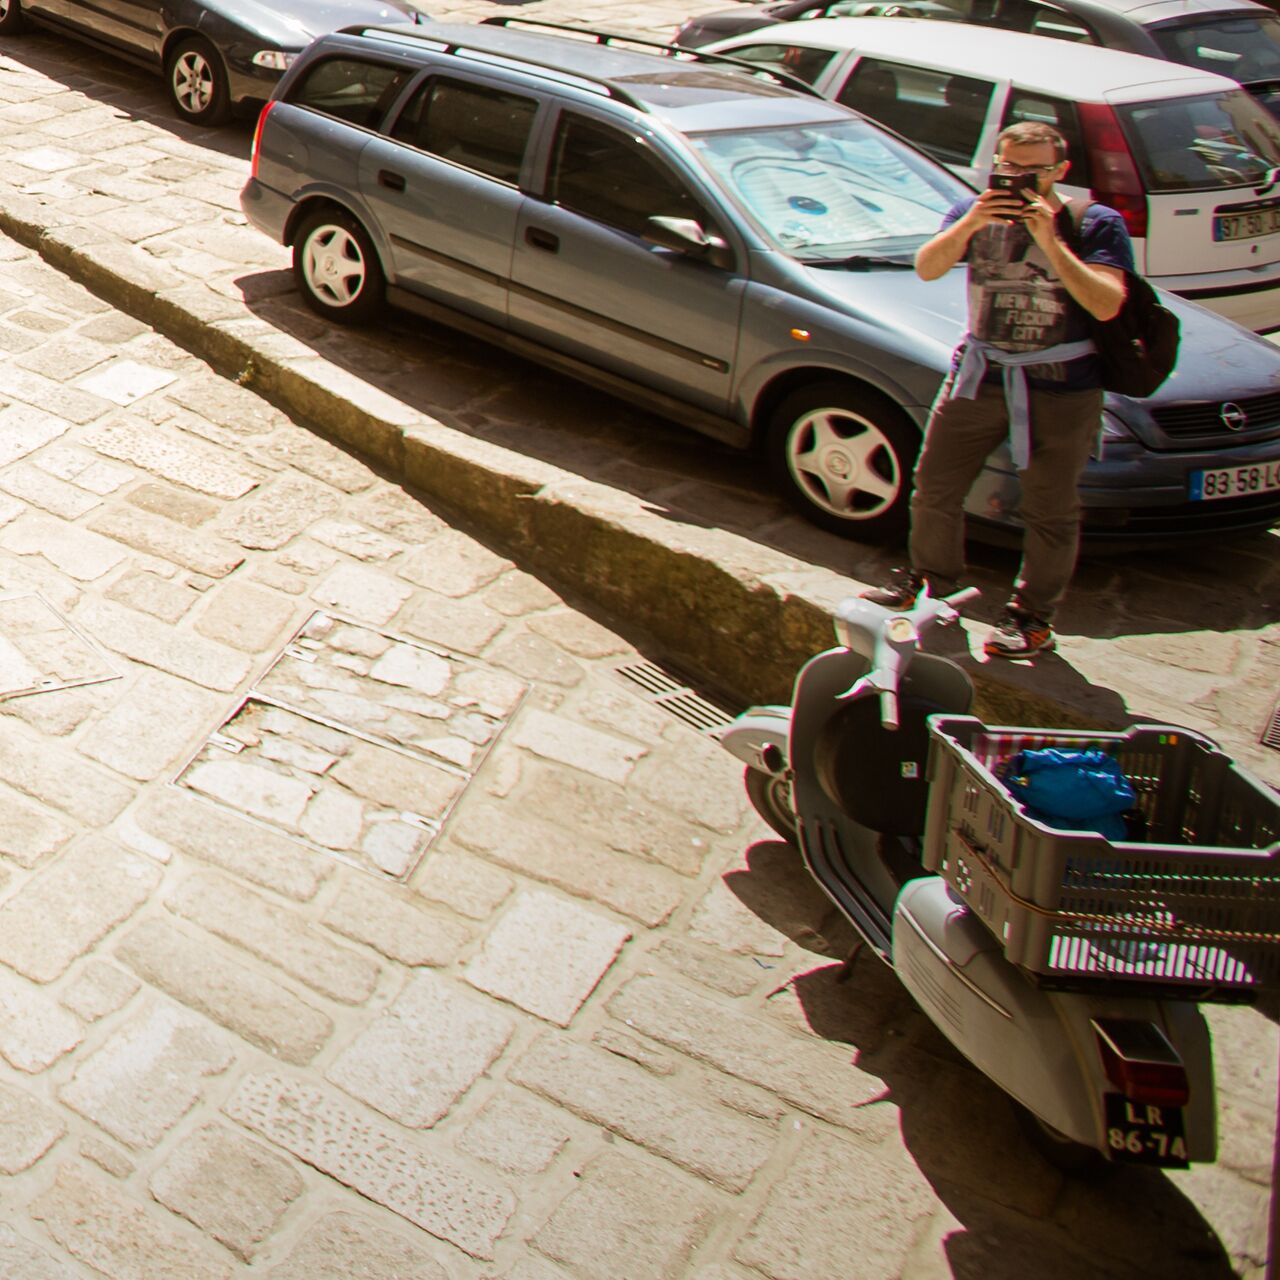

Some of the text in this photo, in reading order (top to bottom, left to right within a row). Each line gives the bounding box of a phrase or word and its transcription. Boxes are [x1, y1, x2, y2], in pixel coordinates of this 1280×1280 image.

[995, 293, 1031, 309] NEW
[1012, 326, 1045, 340] CITY
[1108, 1128, 1187, 1159] 86-74
